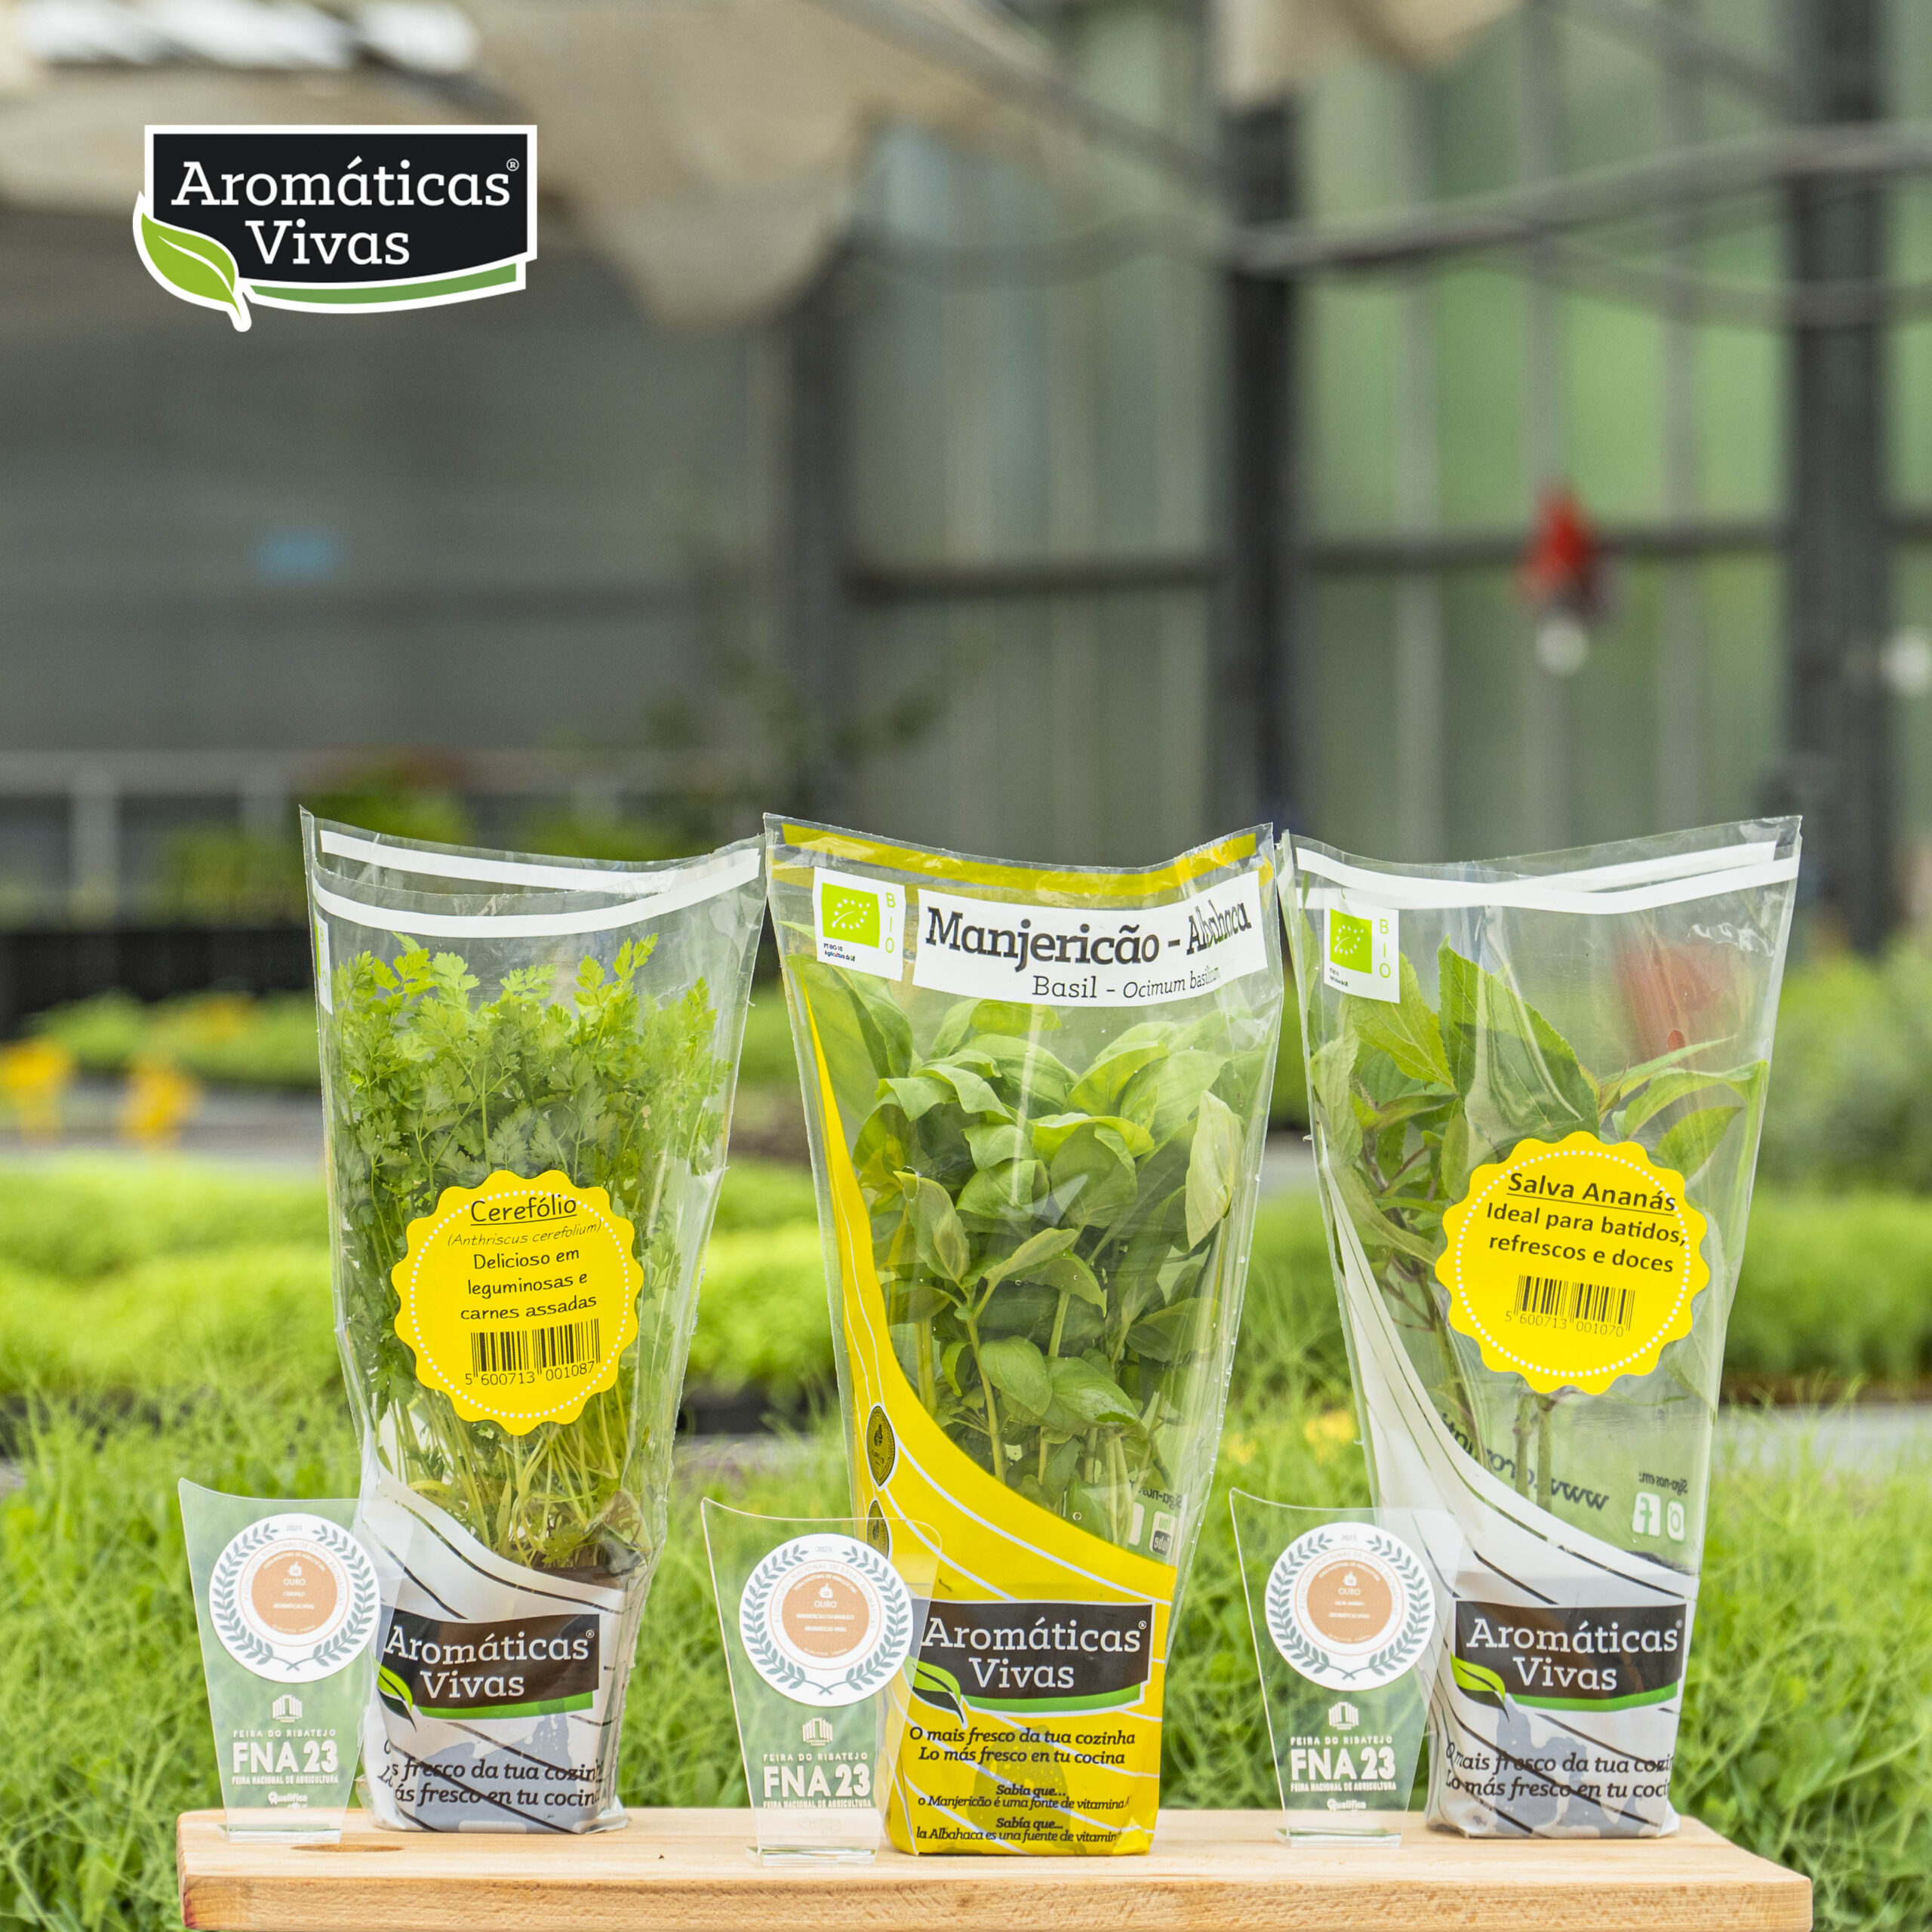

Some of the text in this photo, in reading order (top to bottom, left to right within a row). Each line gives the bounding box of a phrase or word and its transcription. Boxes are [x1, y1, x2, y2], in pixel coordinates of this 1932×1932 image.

[925, 906, 1160, 973] Manjericão
[1032, 975, 1098, 998] Basil
[1123, 979, 1186, 998] Ocimum
[1508, 1172, 1676, 1212] Salva Ananás
[470, 1194, 577, 1223] Cerefólio
[448, 1219, 602, 1247] (Anthriscus cerefolium)
[1487, 1202, 1687, 1247] Ideal para batidos,
[473, 1250, 580, 1269] Delicioso em
[1489, 1234, 1674, 1273] refrescos e doces
[468, 1273, 588, 1299] leguminosas e
[460, 1295, 597, 1321] carnes assadas
[1504, 1311, 1624, 1338] 5 600713 001070
[465, 1361, 595, 1386] 5 600713 001087
[283, 1578, 306, 1586] OURO
[814, 1600, 837, 1608] OURO
[420, 1669, 525, 1699] Vivas
[968, 1657, 1075, 1689] Vivas
[1512, 1656, 1617, 1690] Vivas
[232, 1729, 337, 1738] FEIRA DO RIBATEJO
[909, 1727, 1136, 1747] O mais fresco da tua cozinha
[1291, 1736, 1393, 1746] FEIRA DO RIBATEJO
[232, 1740, 339, 1774] FNA 23
[763, 1752, 868, 1762] FEIRA DO RIBATEJO
[918, 1746, 1125, 1764] Lo más fresco en tu cocina
[1291, 1746, 1396, 1781] FNA 23
[1454, 1751, 1490, 1770] mais
[1492, 1751, 1555, 1775] fresco
[1561, 1752, 1589, 1772] da
[1594, 1757, 1629, 1773] tua
[232, 1774, 339, 1785] FEIRA NACIONAL DE AGRICULTURA
[401, 1756, 465, 1781] fresco
[471, 1759, 499, 1779] da
[503, 1762, 540, 1780] tua
[764, 1763, 871, 1798] FNA 23
[417, 1783, 481, 1807] fresco
[488, 1789, 512, 1804] en
[517, 1788, 538, 1805] tu
[1291, 1783, 1309, 1792] FEIRA
[1310, 1783, 1343, 1792] NACIONAL
[1354, 1782, 1397, 1791] AGRICULTURA
[1446, 1769, 1461, 1789] Lo
[1466, 1777, 1506, 1795] más
[1508, 1777, 1573, 1801] fresco
[1577, 1784, 1601, 1798] en
[1606, 1782, 1628, 1798] tu
[763, 1801, 782, 1809] FEIRA
[783, 1800, 816, 1809] NACIONAL
[828, 1799, 872, 1808] AGRICULTURA
[918, 1798, 925, 1806] o
[928, 1795, 992, 1810] Manjericão
[994, 1796, 1001, 1807] é
[1002, 1799, 1029, 1807] uma
[1028, 1796, 1059, 1810] fonte
[1061, 1796, 1075, 1808] de
[1076, 1798, 1124, 1810] vitamina
[917, 1827, 927, 1839] la
[927, 1828, 985, 1840] Albahaca
[986, 1832, 996, 1840] es
[998, 1832, 1020, 1841] una
[1021, 1829, 1057, 1843] fuente
[1060, 1829, 1075, 1841] de
[1032, 1820, 1063, 1832] que...
